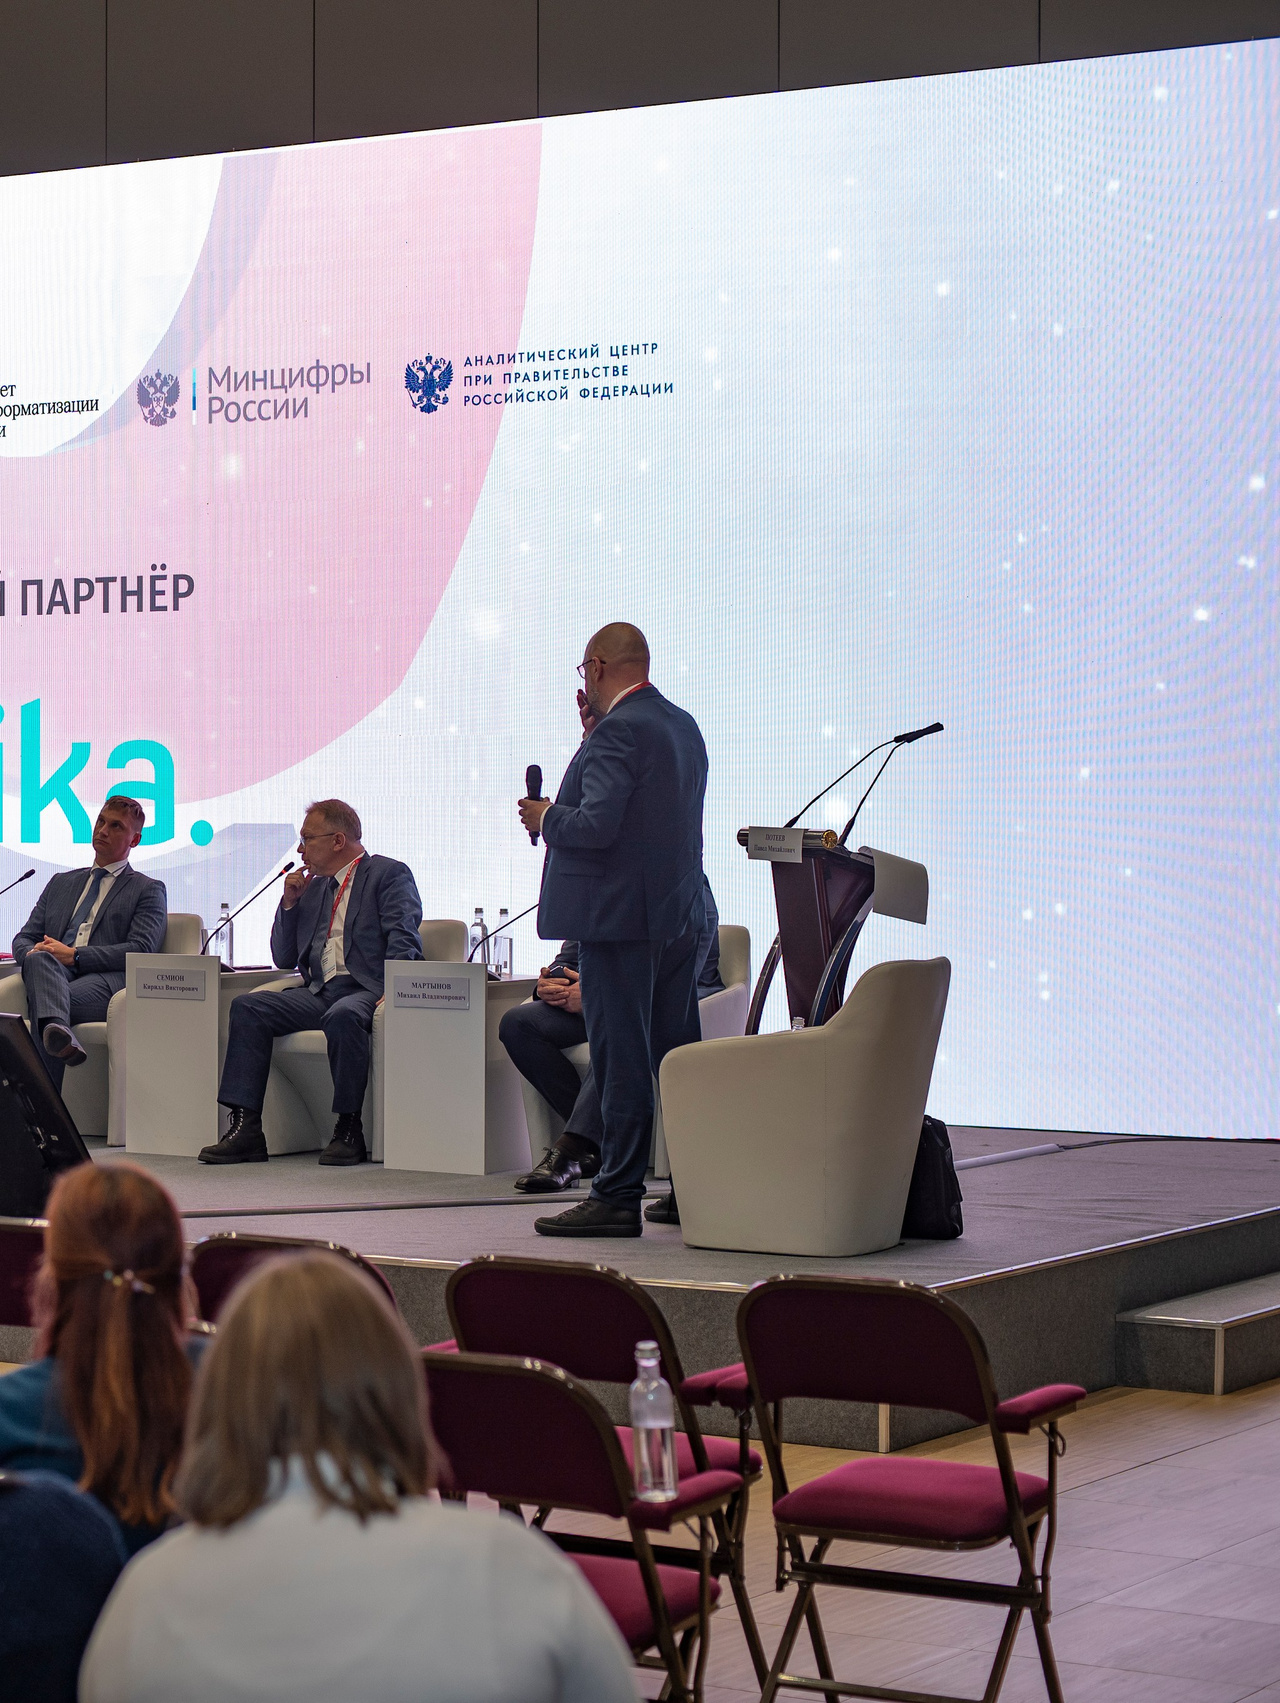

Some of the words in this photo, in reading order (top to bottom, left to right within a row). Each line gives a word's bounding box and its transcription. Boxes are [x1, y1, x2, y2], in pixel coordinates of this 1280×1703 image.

[463, 343, 599, 367] АНАЛИТИЧЕСКИЙ
[609, 342, 658, 359] ЦЕНТР
[208, 359, 371, 394] Минцифры
[463, 374, 492, 387] ПРИ
[503, 364, 628, 385] ПРАВИТЕЛЬСТВЕ
[463, 385, 568, 406] РОССИЙСКОЙ
[579, 382, 673, 400] ФЕДЕРАЦИИ
[208, 396, 309, 424] России
[20, 563, 195, 616] ПАРТНЁР
[143, 983, 165, 991] Кирилл
[165, 984, 199, 993] Викторович
[156, 974, 185, 982] СЕМИОН
[411, 982, 452, 990] МАРТЫНОВ
[396, 991, 421, 999] Михаил
[421, 992, 466, 1002] Владимирович
